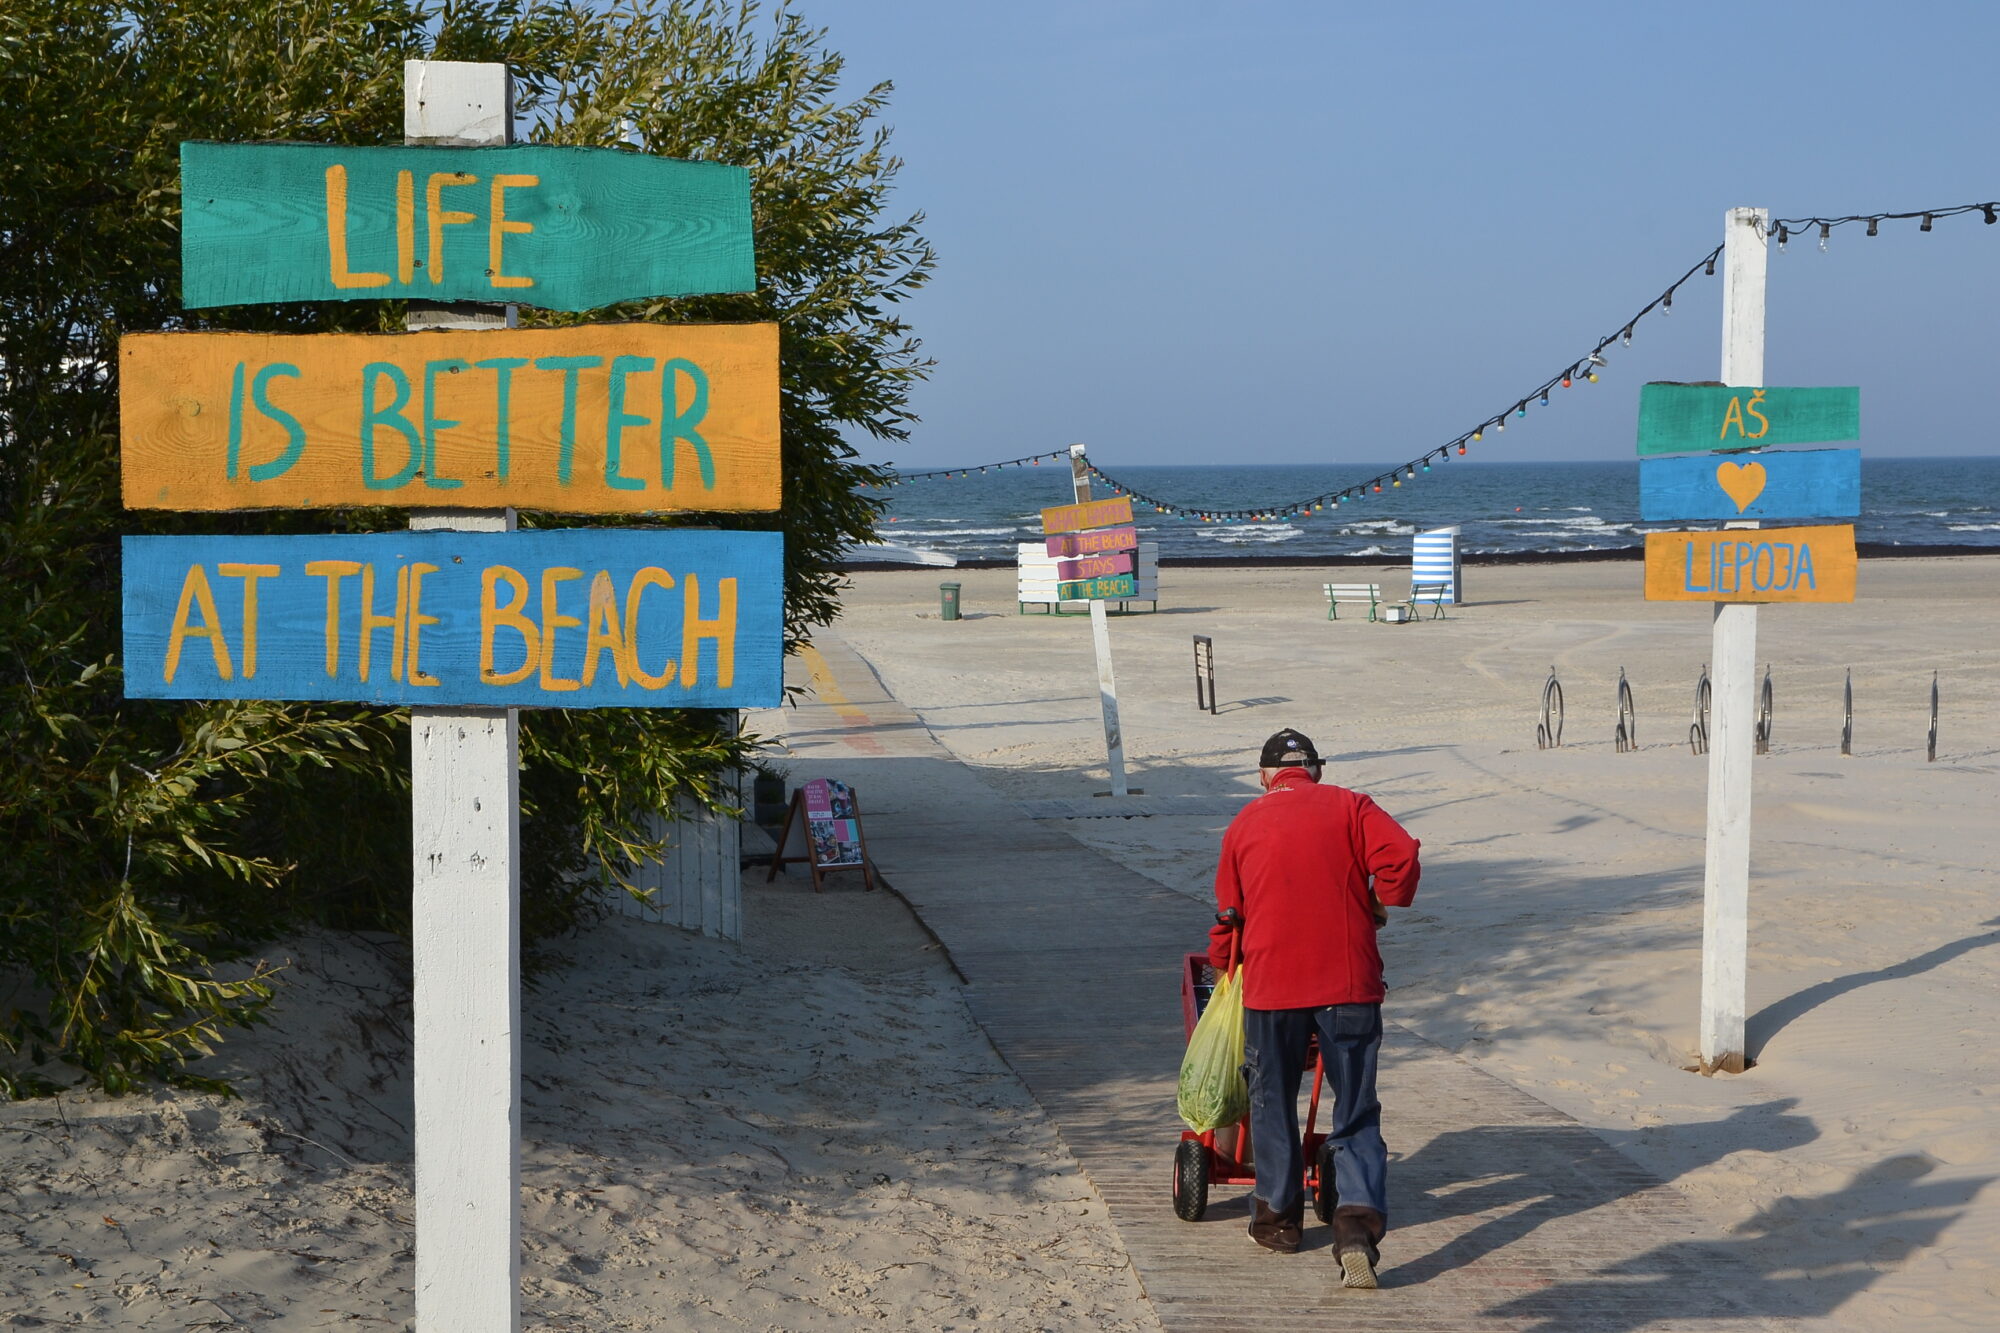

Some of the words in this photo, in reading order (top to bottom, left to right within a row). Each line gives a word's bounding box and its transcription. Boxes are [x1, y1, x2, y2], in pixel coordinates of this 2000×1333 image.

[326, 164, 539, 289] LIFE
[226, 361, 306, 483] IS
[360, 354, 715, 491] BETTER
[1720, 389, 1769, 440] AŠ
[1044, 508, 1081, 531] WHAT
[1086, 503, 1131, 524] HAPPENS
[1061, 539, 1073, 553] AT
[1078, 537, 1098, 551] THE
[1102, 535, 1133, 549] BEACH
[1077, 559, 1114, 577] STAYS
[1685, 541, 1816, 593] LIEPOJA
[1060, 584, 1073, 598] AT
[1078, 581, 1094, 597] THE
[1097, 580, 1128, 596] BEACH
[164, 562, 280, 685] AT
[305, 560, 441, 686] THE
[479, 565, 737, 691] BEACH
